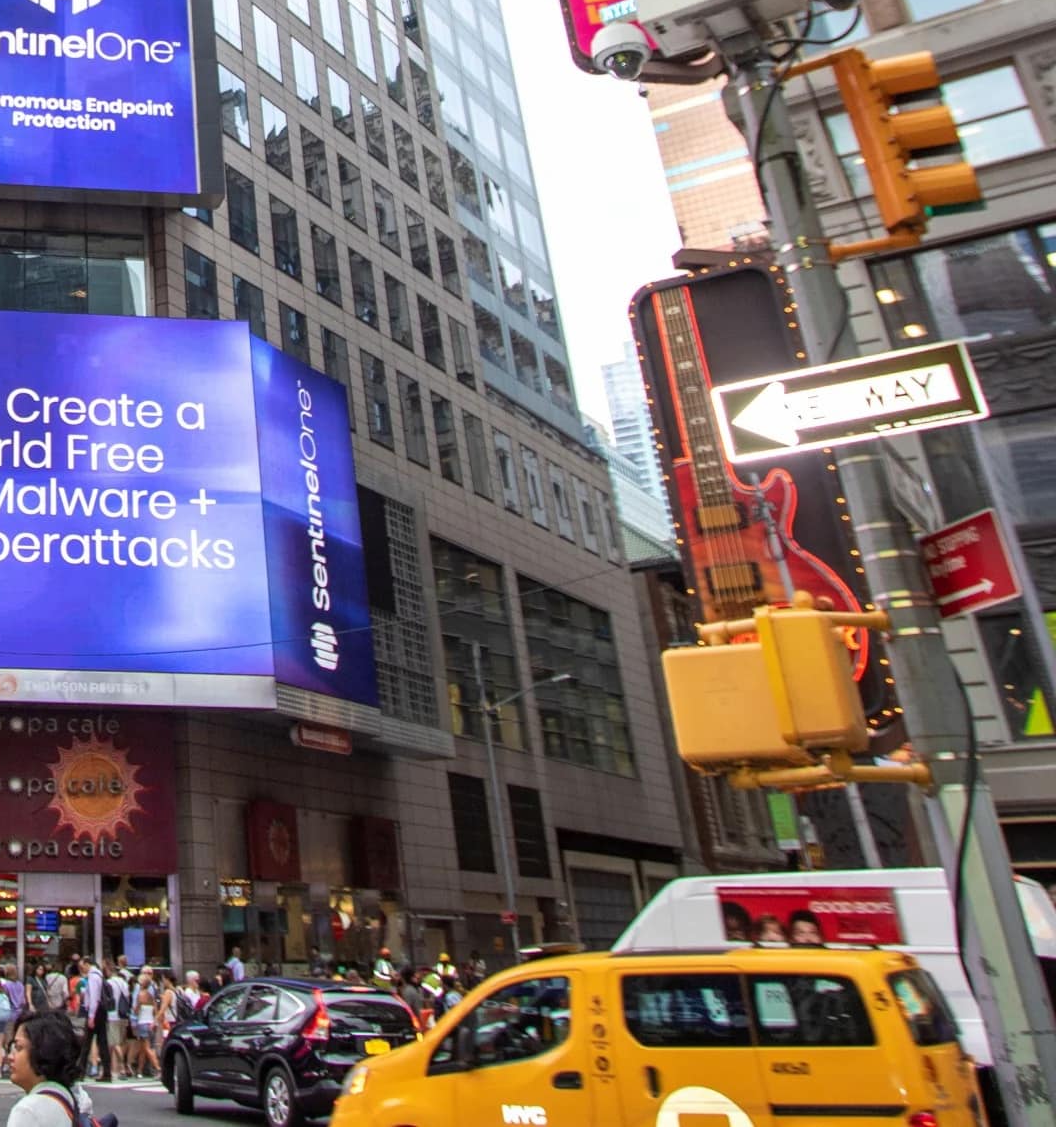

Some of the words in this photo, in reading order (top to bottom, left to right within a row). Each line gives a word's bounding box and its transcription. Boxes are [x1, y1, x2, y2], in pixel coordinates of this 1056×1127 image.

[12, 110, 116, 132] Protection
[86, 96, 174, 119] Endpoint
[865, 373, 934, 410] WAY
[6, 387, 163, 430] Create
[176, 402, 206, 430] a
[67, 434, 164, 473] Free
[189, 489, 217, 515] +
